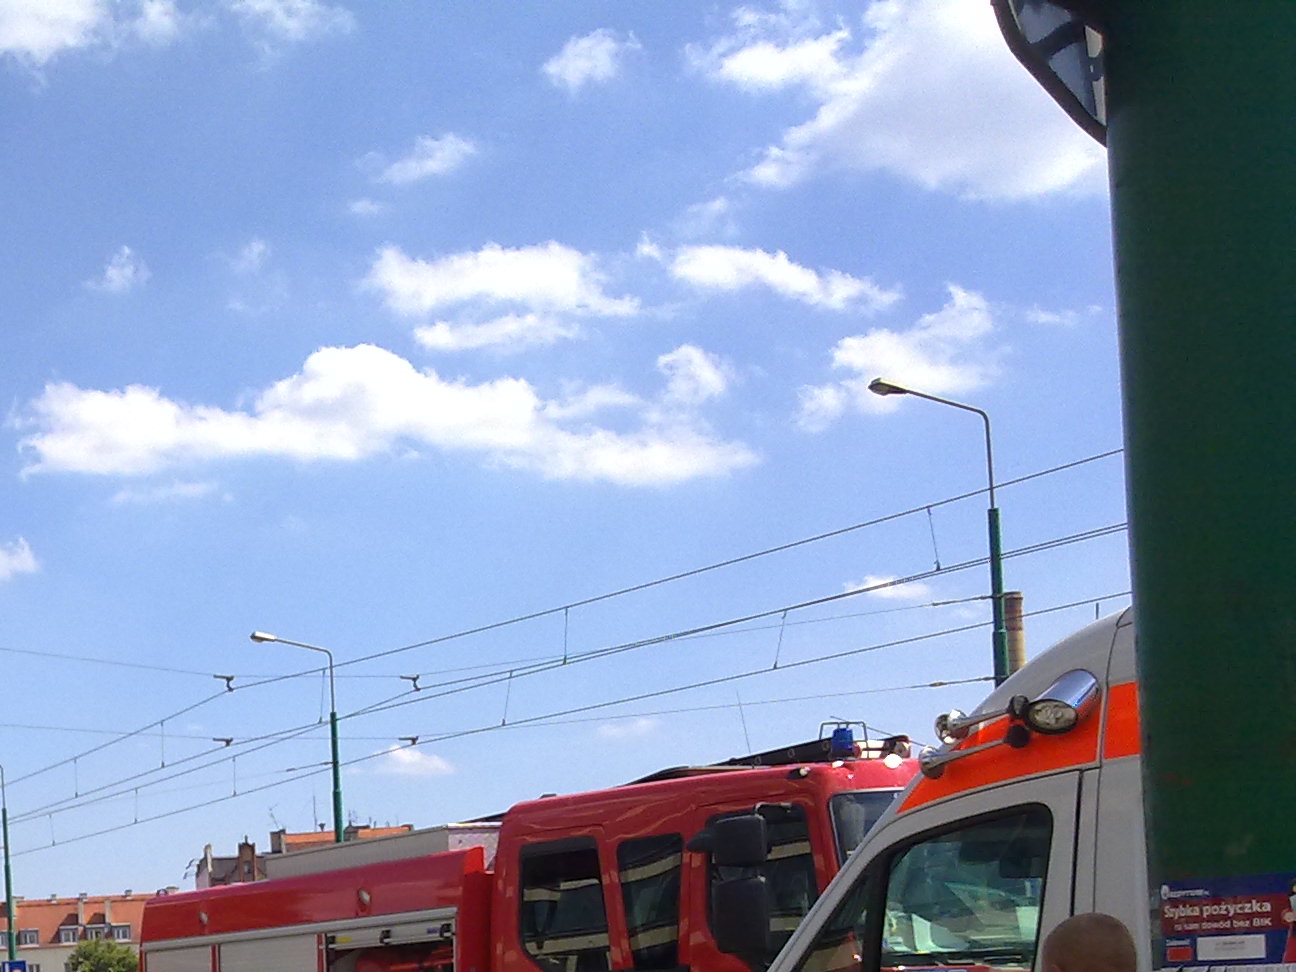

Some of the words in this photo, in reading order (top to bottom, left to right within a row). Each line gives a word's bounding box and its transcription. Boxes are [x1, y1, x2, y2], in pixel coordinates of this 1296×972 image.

[1164, 905, 1200, 919] Szybka
[1202, 900, 1272, 917] pożyczka
[1233, 919, 1250, 927] bez
[1252, 917, 1272, 927] BIK
